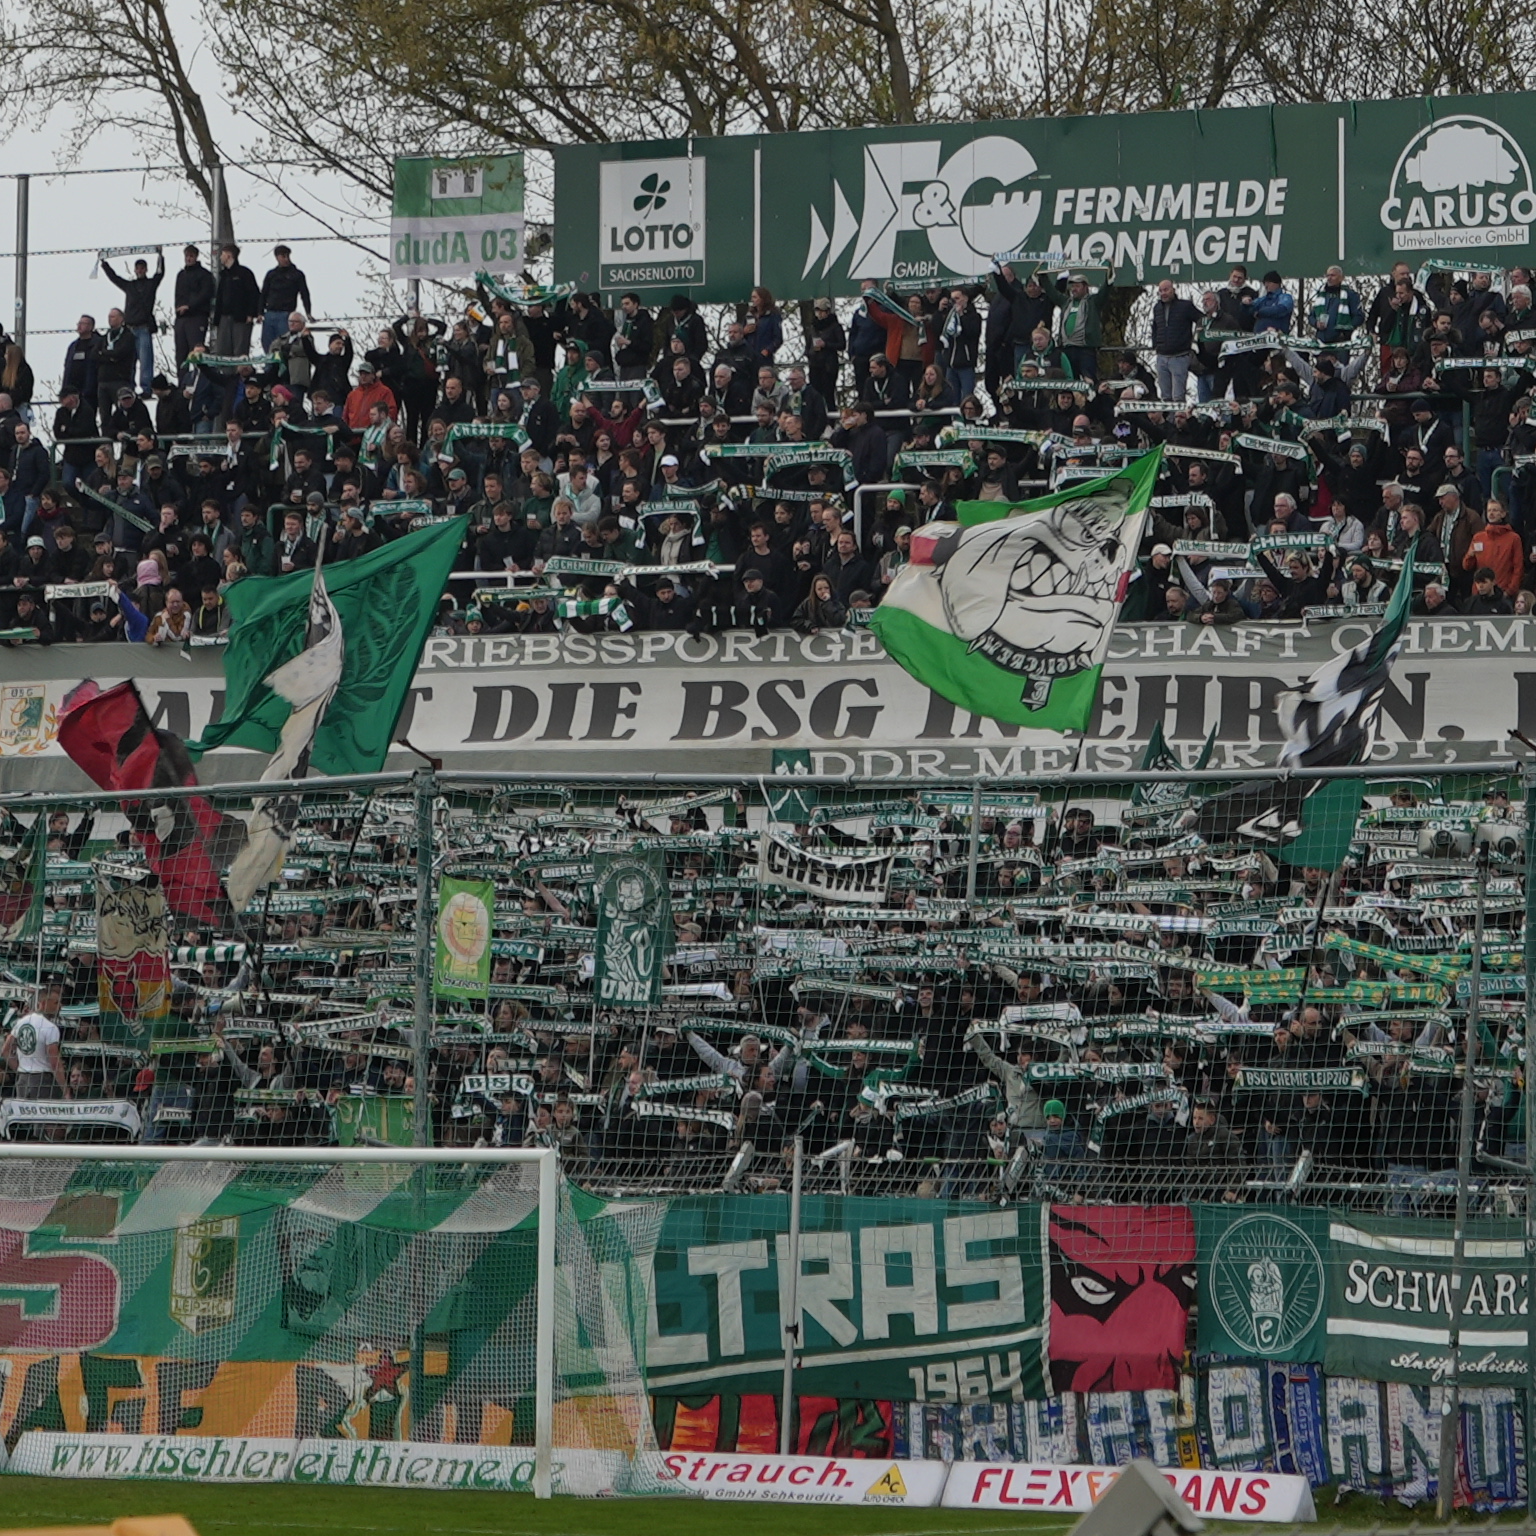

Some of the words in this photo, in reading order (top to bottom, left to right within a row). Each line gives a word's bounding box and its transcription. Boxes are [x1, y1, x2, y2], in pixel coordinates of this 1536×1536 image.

[1053, 178, 1288, 225] FERNMELDE
[395, 231, 470, 265] dudA
[481, 227, 518, 262] 03
[610, 222, 694, 253] LOTTO
[1042, 224, 1282, 270] MONTAGEN
[1395, 233, 1482, 249] Umweltservice
[1484, 227, 1527, 246] GmbH
[609, 267, 695, 283] SACHSENLOTTO
[894, 261, 939, 279] GMBH
[1253, 533, 1327, 550] CHEMIE
[463, 678, 645, 743] DIE
[670, 676, 885, 743] BSG
[1246, 1071, 1264, 1085] BSG
[1268, 1072, 1309, 1086] CHEMIE
[1311, 1071, 1351, 1085] LEIPZIG
[19, 1103, 39, 1116] BSG
[41, 1103, 79, 1116] CHEMIE
[81, 1103, 115, 1117] LEIPZIG
[642, 1208, 1024, 1369] LTRAS
[908, 1349, 1030, 1404] 1964
[662, 1454, 855, 1488] Strauch.
[879, 1473, 901, 1494] AC
[715, 1489, 757, 1501] GmbH
[761, 1490, 844, 1504] Schkeuditz
